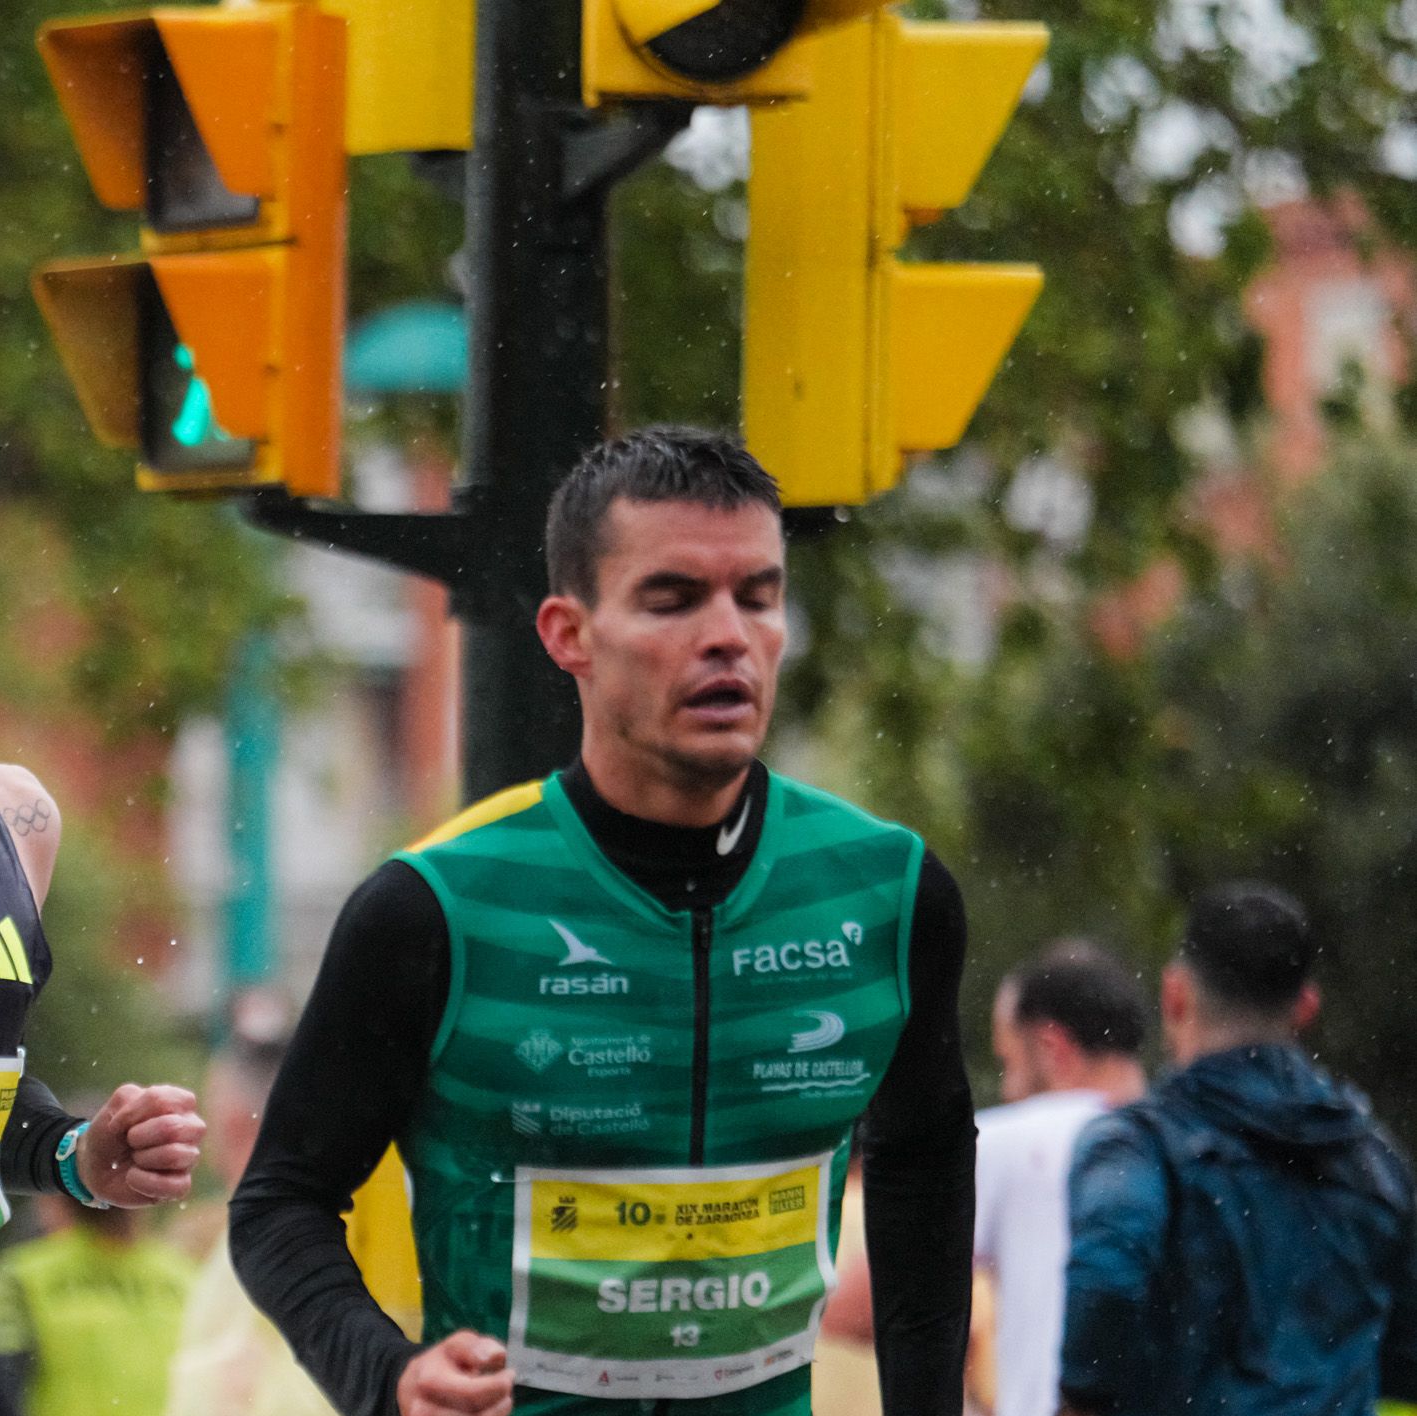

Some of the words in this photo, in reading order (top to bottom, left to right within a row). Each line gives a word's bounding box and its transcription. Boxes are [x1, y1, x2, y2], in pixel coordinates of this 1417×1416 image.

[733, 940, 850, 976] Facsa
[615, 1201, 651, 1226] 10
[597, 1272, 771, 1314] SERGIO
[670, 1323, 700, 1347] 13
